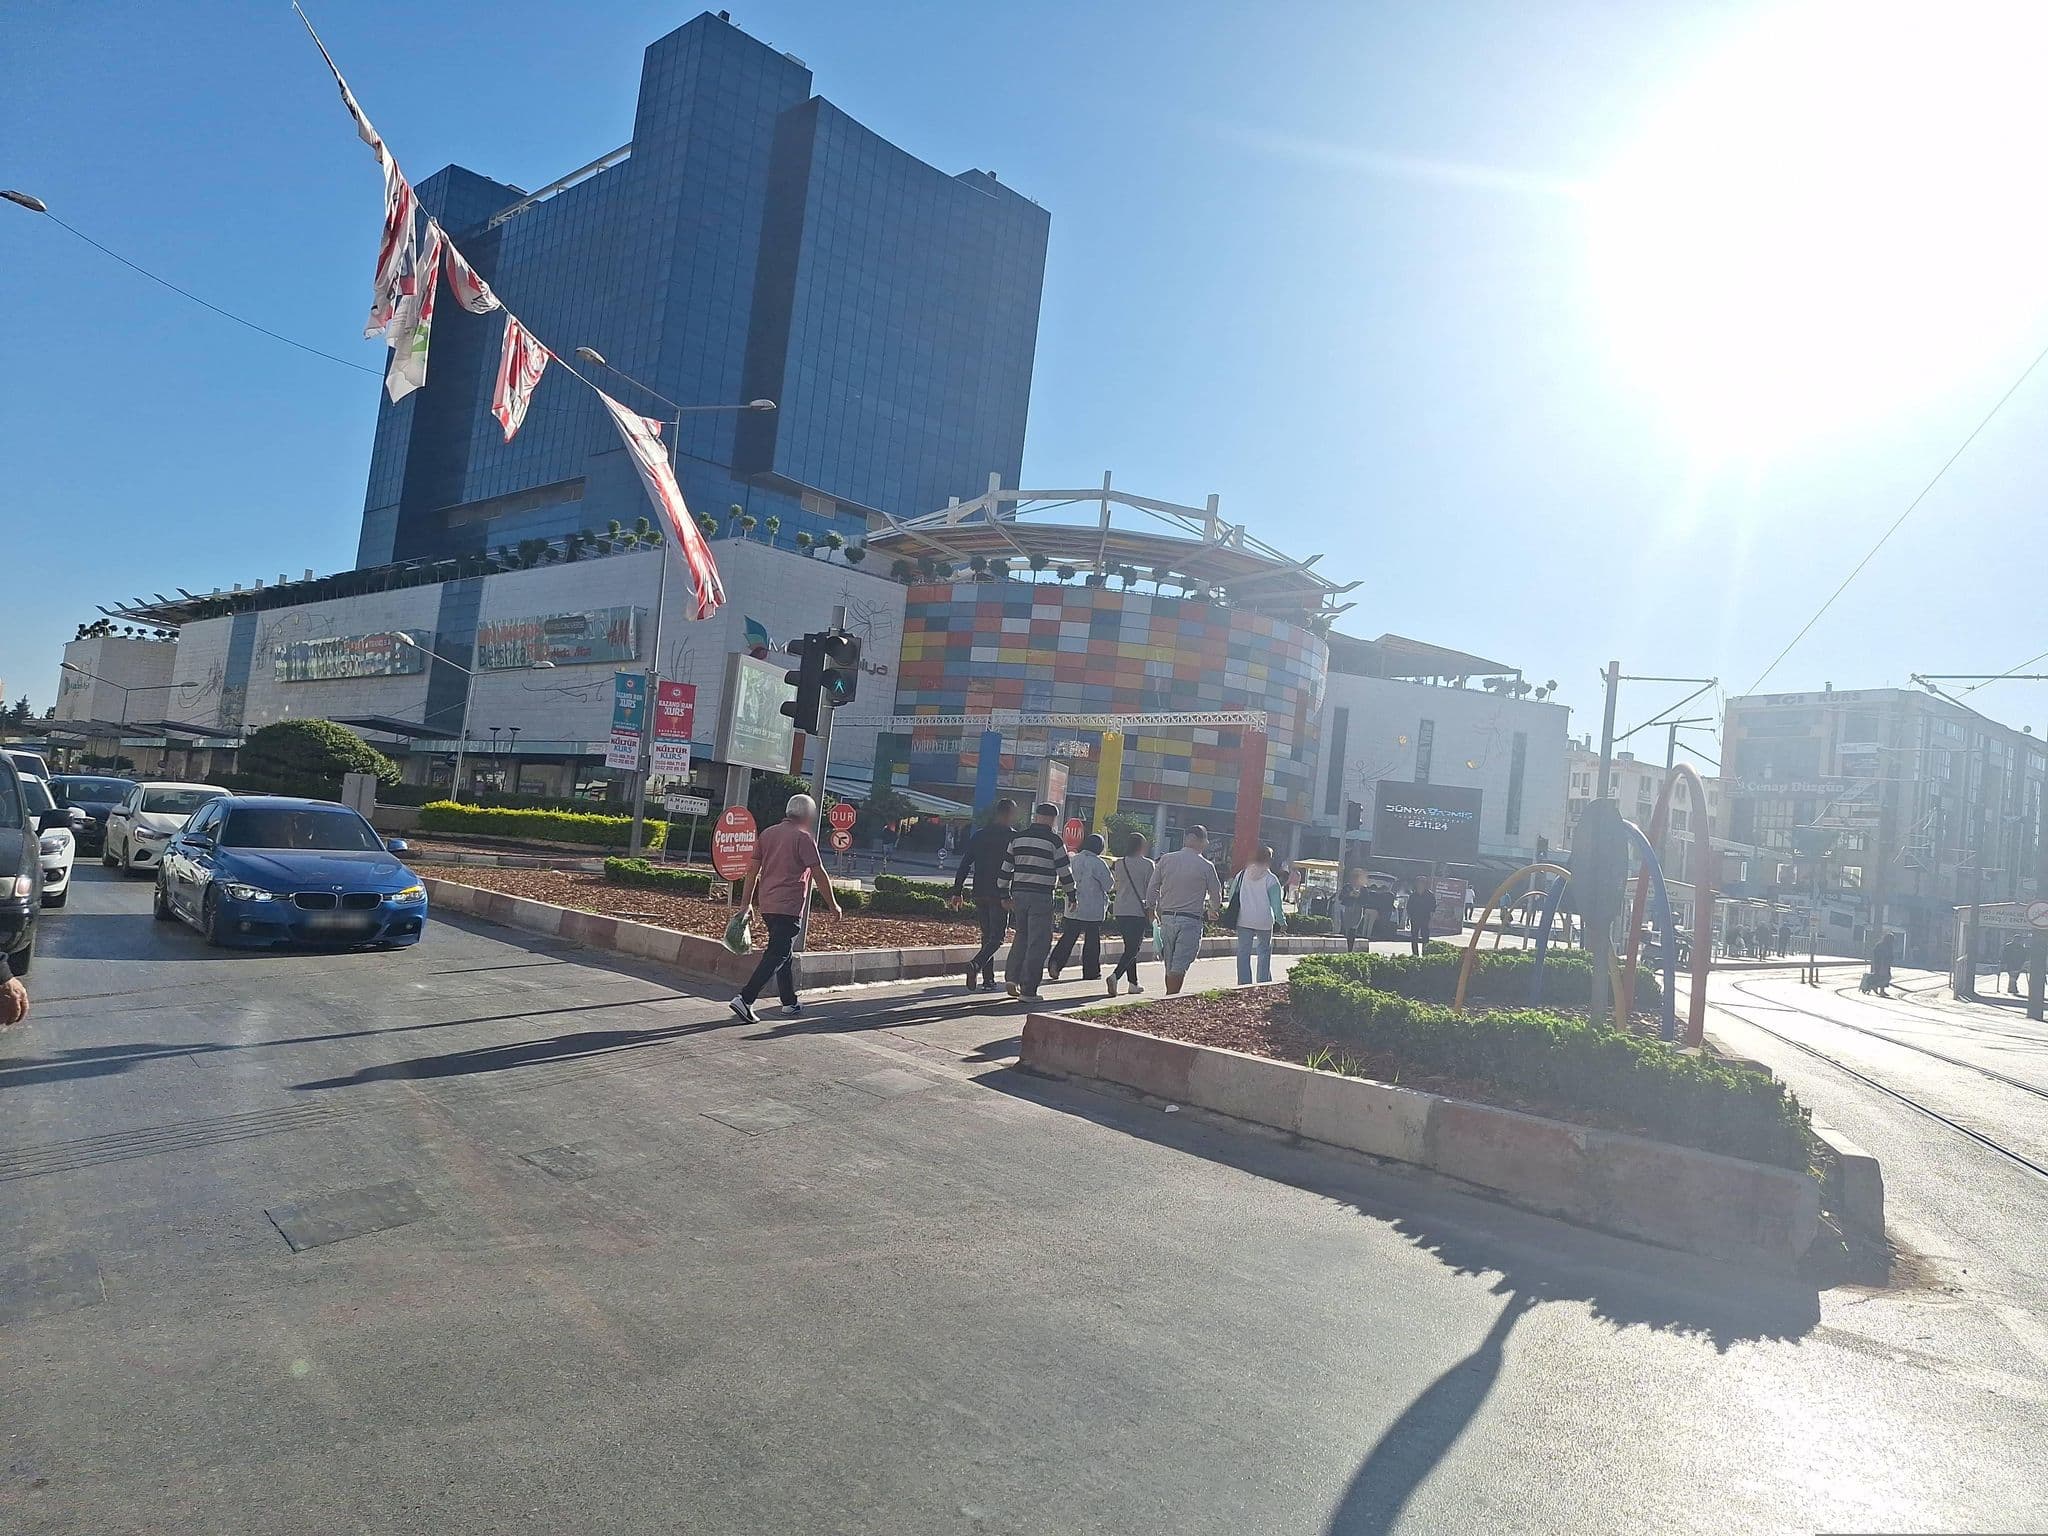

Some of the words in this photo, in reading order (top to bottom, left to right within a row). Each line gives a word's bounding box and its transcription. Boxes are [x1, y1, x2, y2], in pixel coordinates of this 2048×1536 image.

[832, 811, 854, 822] DUR
[1408, 820, 1448, 831] 22.11.24
[715, 829, 756, 847] Çevremizi
